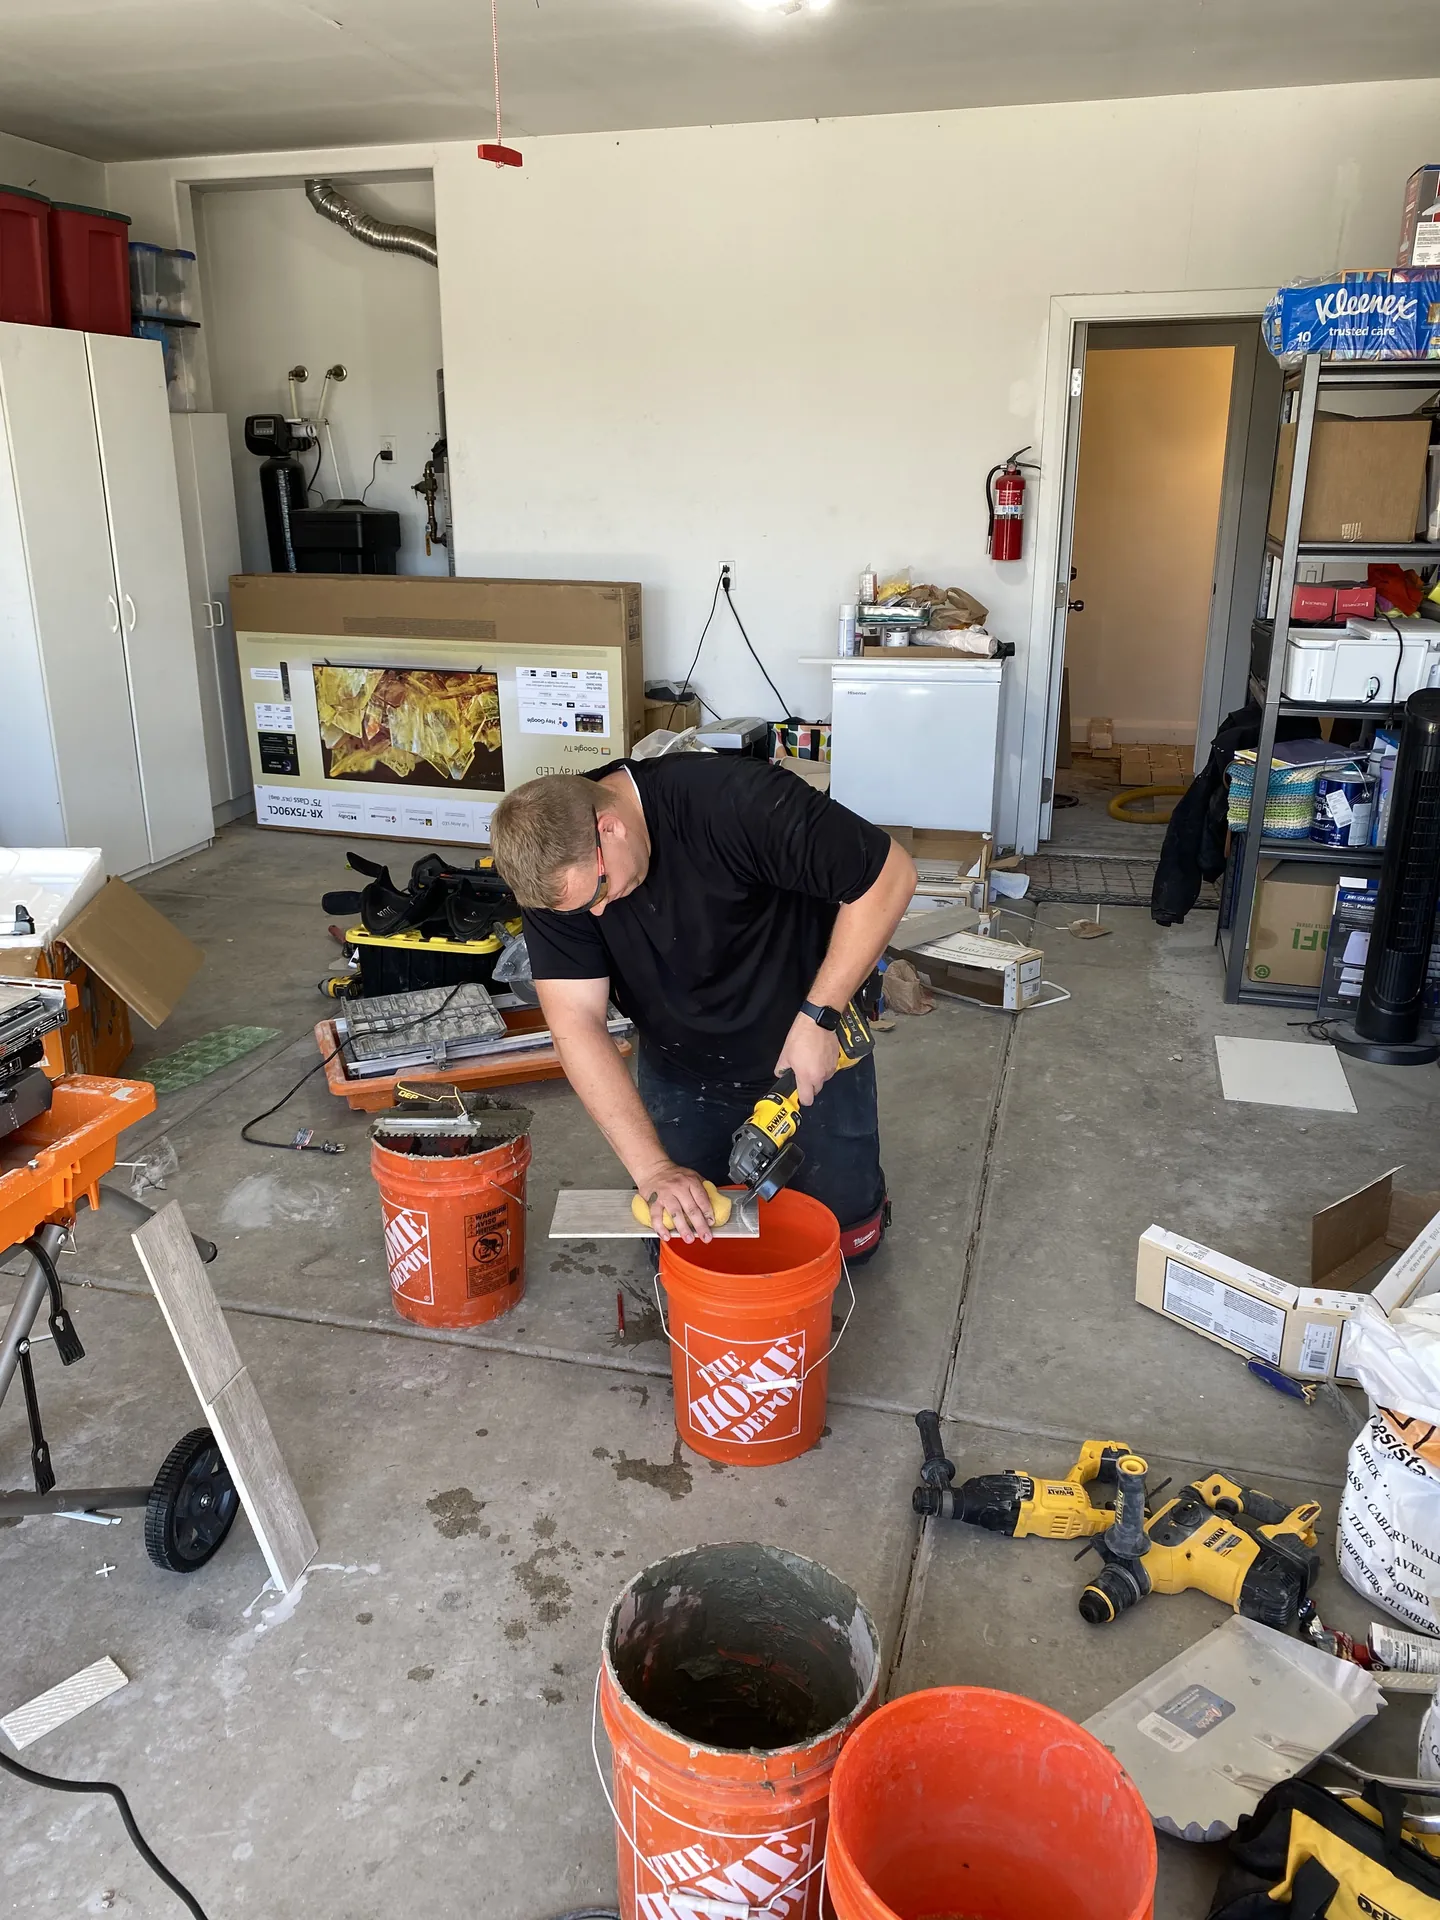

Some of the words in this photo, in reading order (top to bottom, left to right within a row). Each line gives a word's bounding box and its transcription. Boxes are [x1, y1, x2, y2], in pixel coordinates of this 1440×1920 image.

[1315, 287, 1418, 325] Kleenex
[1297, 331, 1311, 343] 10
[1329, 326, 1370, 336] trusted
[1371, 327, 1395, 336] care
[527, 717, 544, 725] Google
[545, 718, 556, 726] Hey
[574, 744, 599, 754] Google
[535, 766, 555, 776] LED
[293, 797, 310, 806] Class
[267, 805, 324, 819] XR-75X90CL
[397, 1090, 419, 1100] QEP
[475, 1205, 507, 1220] WARNING
[476, 1217, 497, 1228] AVISO
[696, 1350, 747, 1388] THE
[690, 1337, 805, 1436] HOME
[1355, 1443, 1383, 1480] BRICK
[1347, 1469, 1364, 1492] ASS
[1348, 1513, 1377, 1549] TILES
[1391, 1529, 1410, 1546] RY
[1340, 1530, 1382, 1594] CARPENTERS
[1394, 1556, 1426, 1580] AVEL
[1383, 1596, 1440, 1635] PLUMBERS
[646, 1843, 721, 1886] THE
